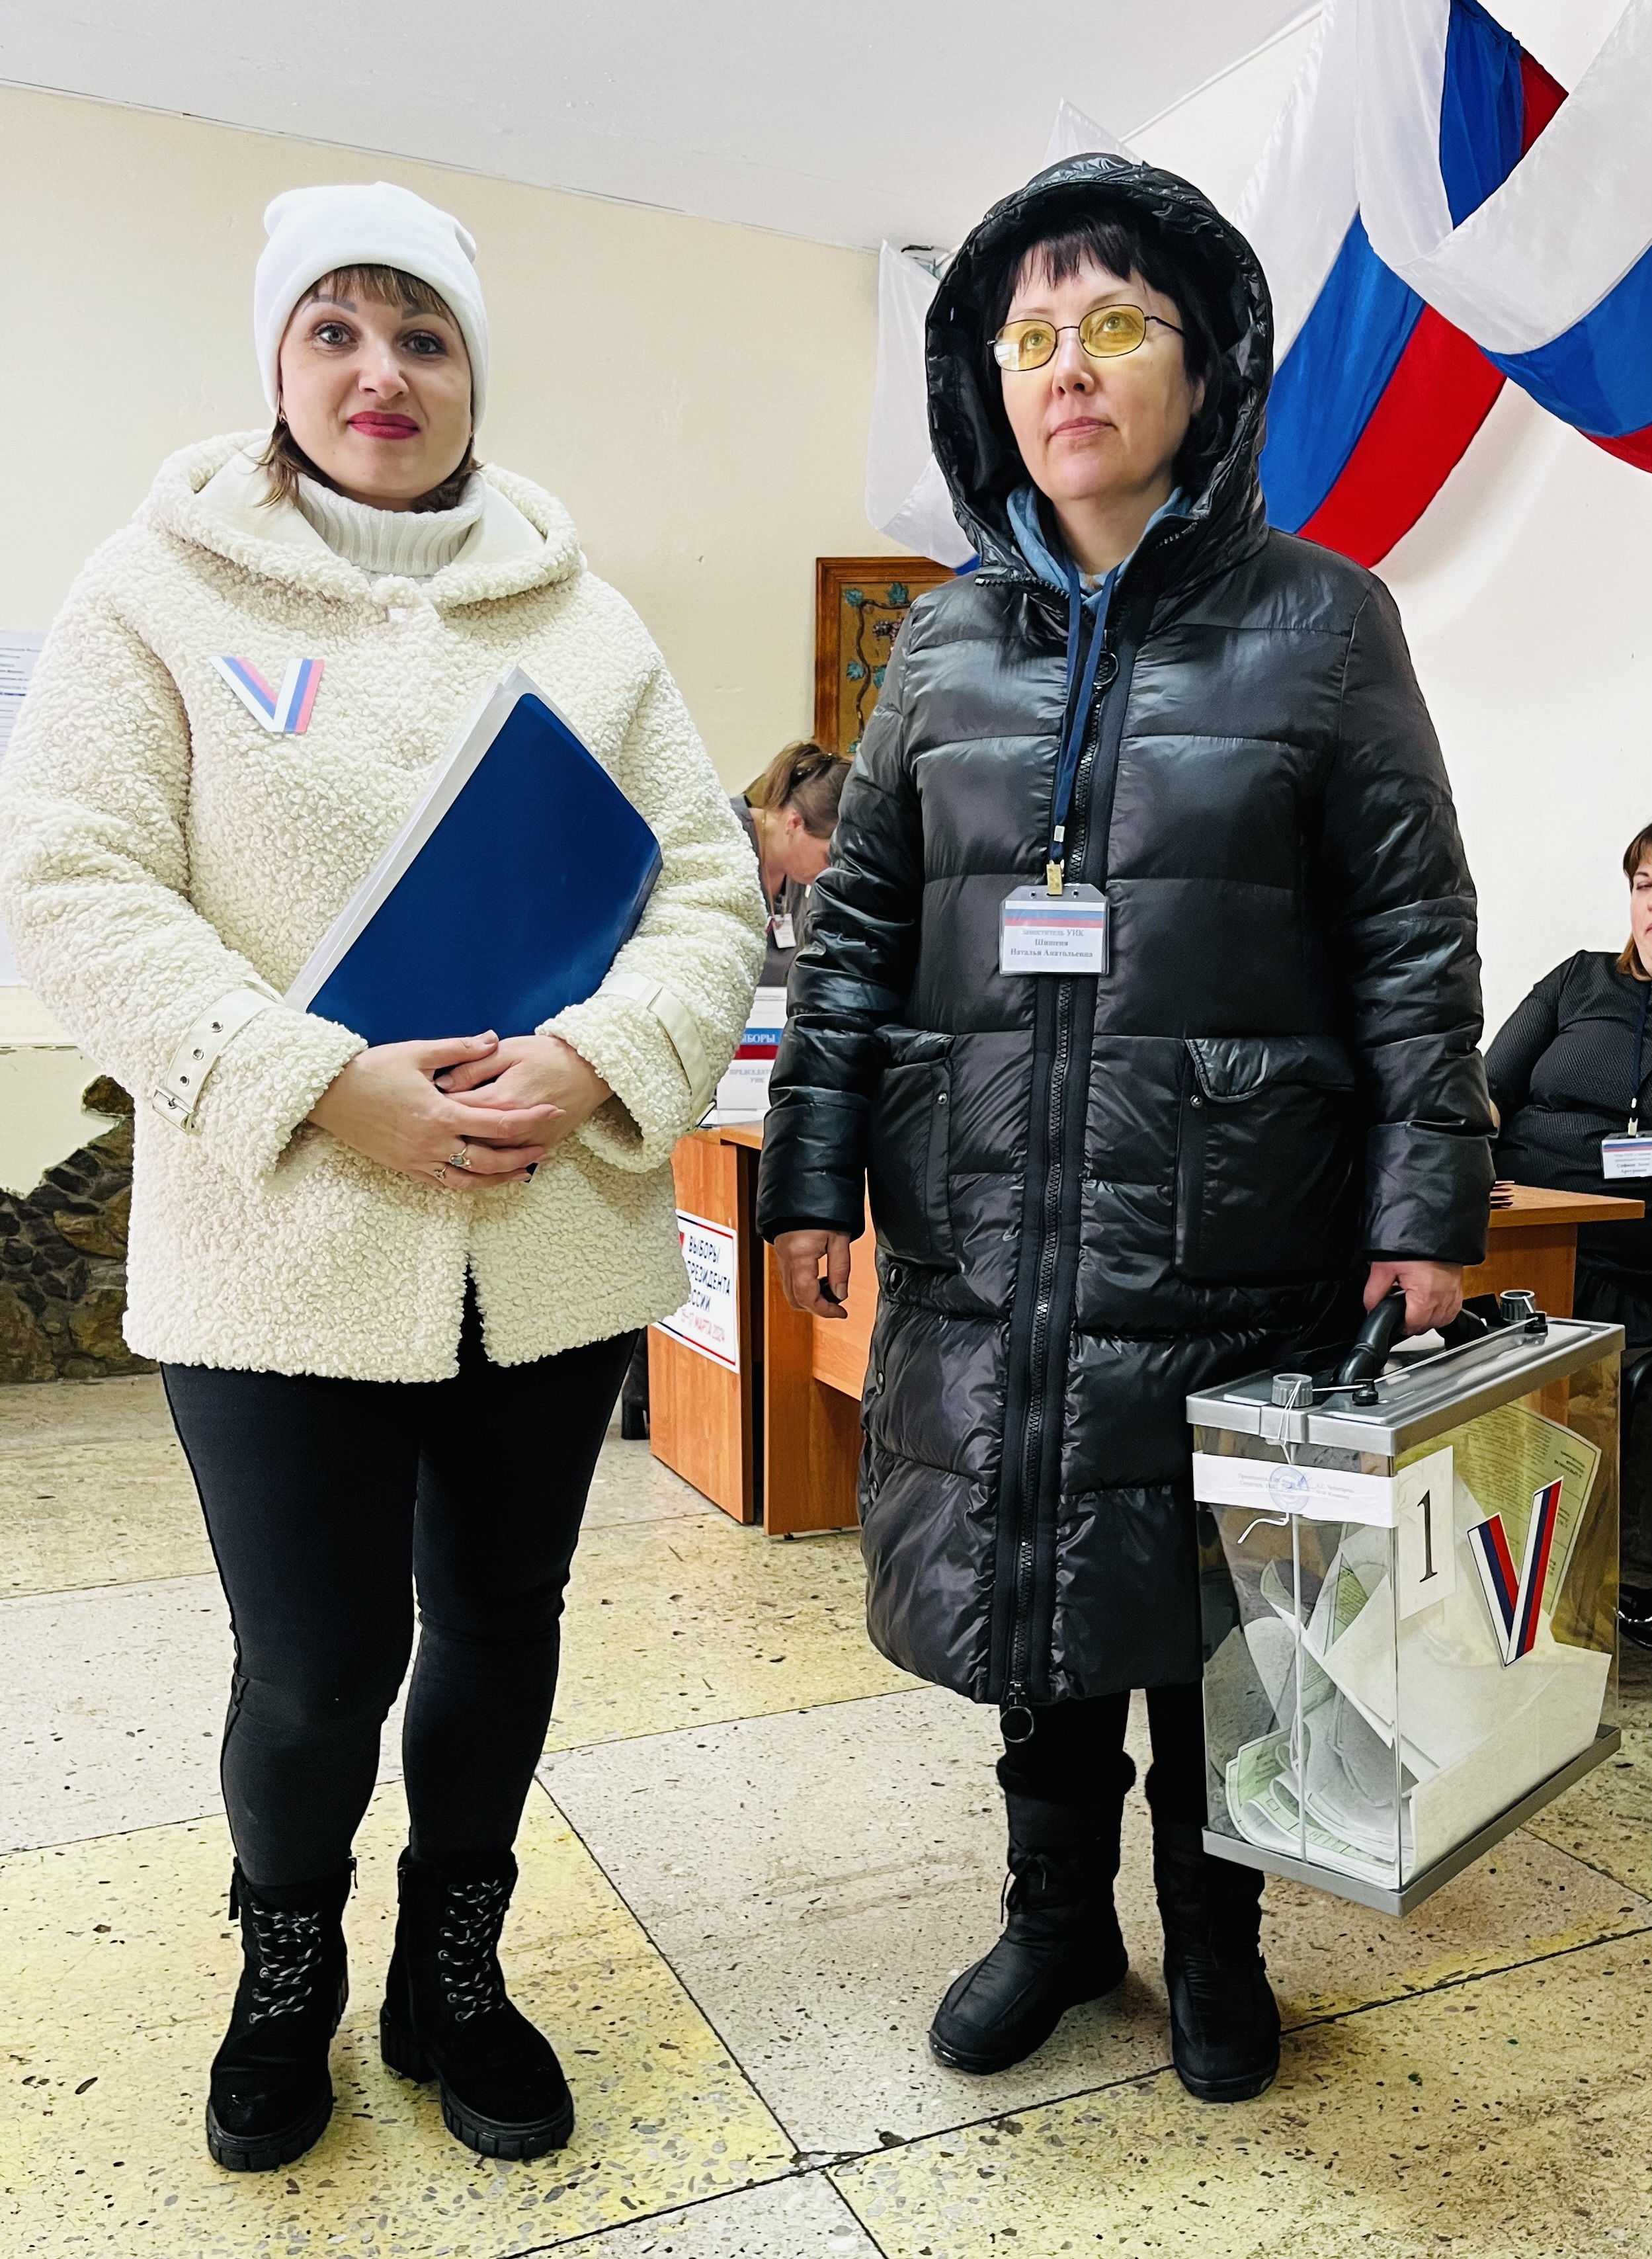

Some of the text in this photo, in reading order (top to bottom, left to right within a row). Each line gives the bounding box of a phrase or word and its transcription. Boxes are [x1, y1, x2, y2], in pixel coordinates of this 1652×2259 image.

[741, 1034, 775, 1043] ЫБОРЫ
[688, 1235, 720, 1264] ВЫБОРЫ
[688, 1289, 711, 1313] ССИИ
[1417, 1489, 1438, 1583] 1
